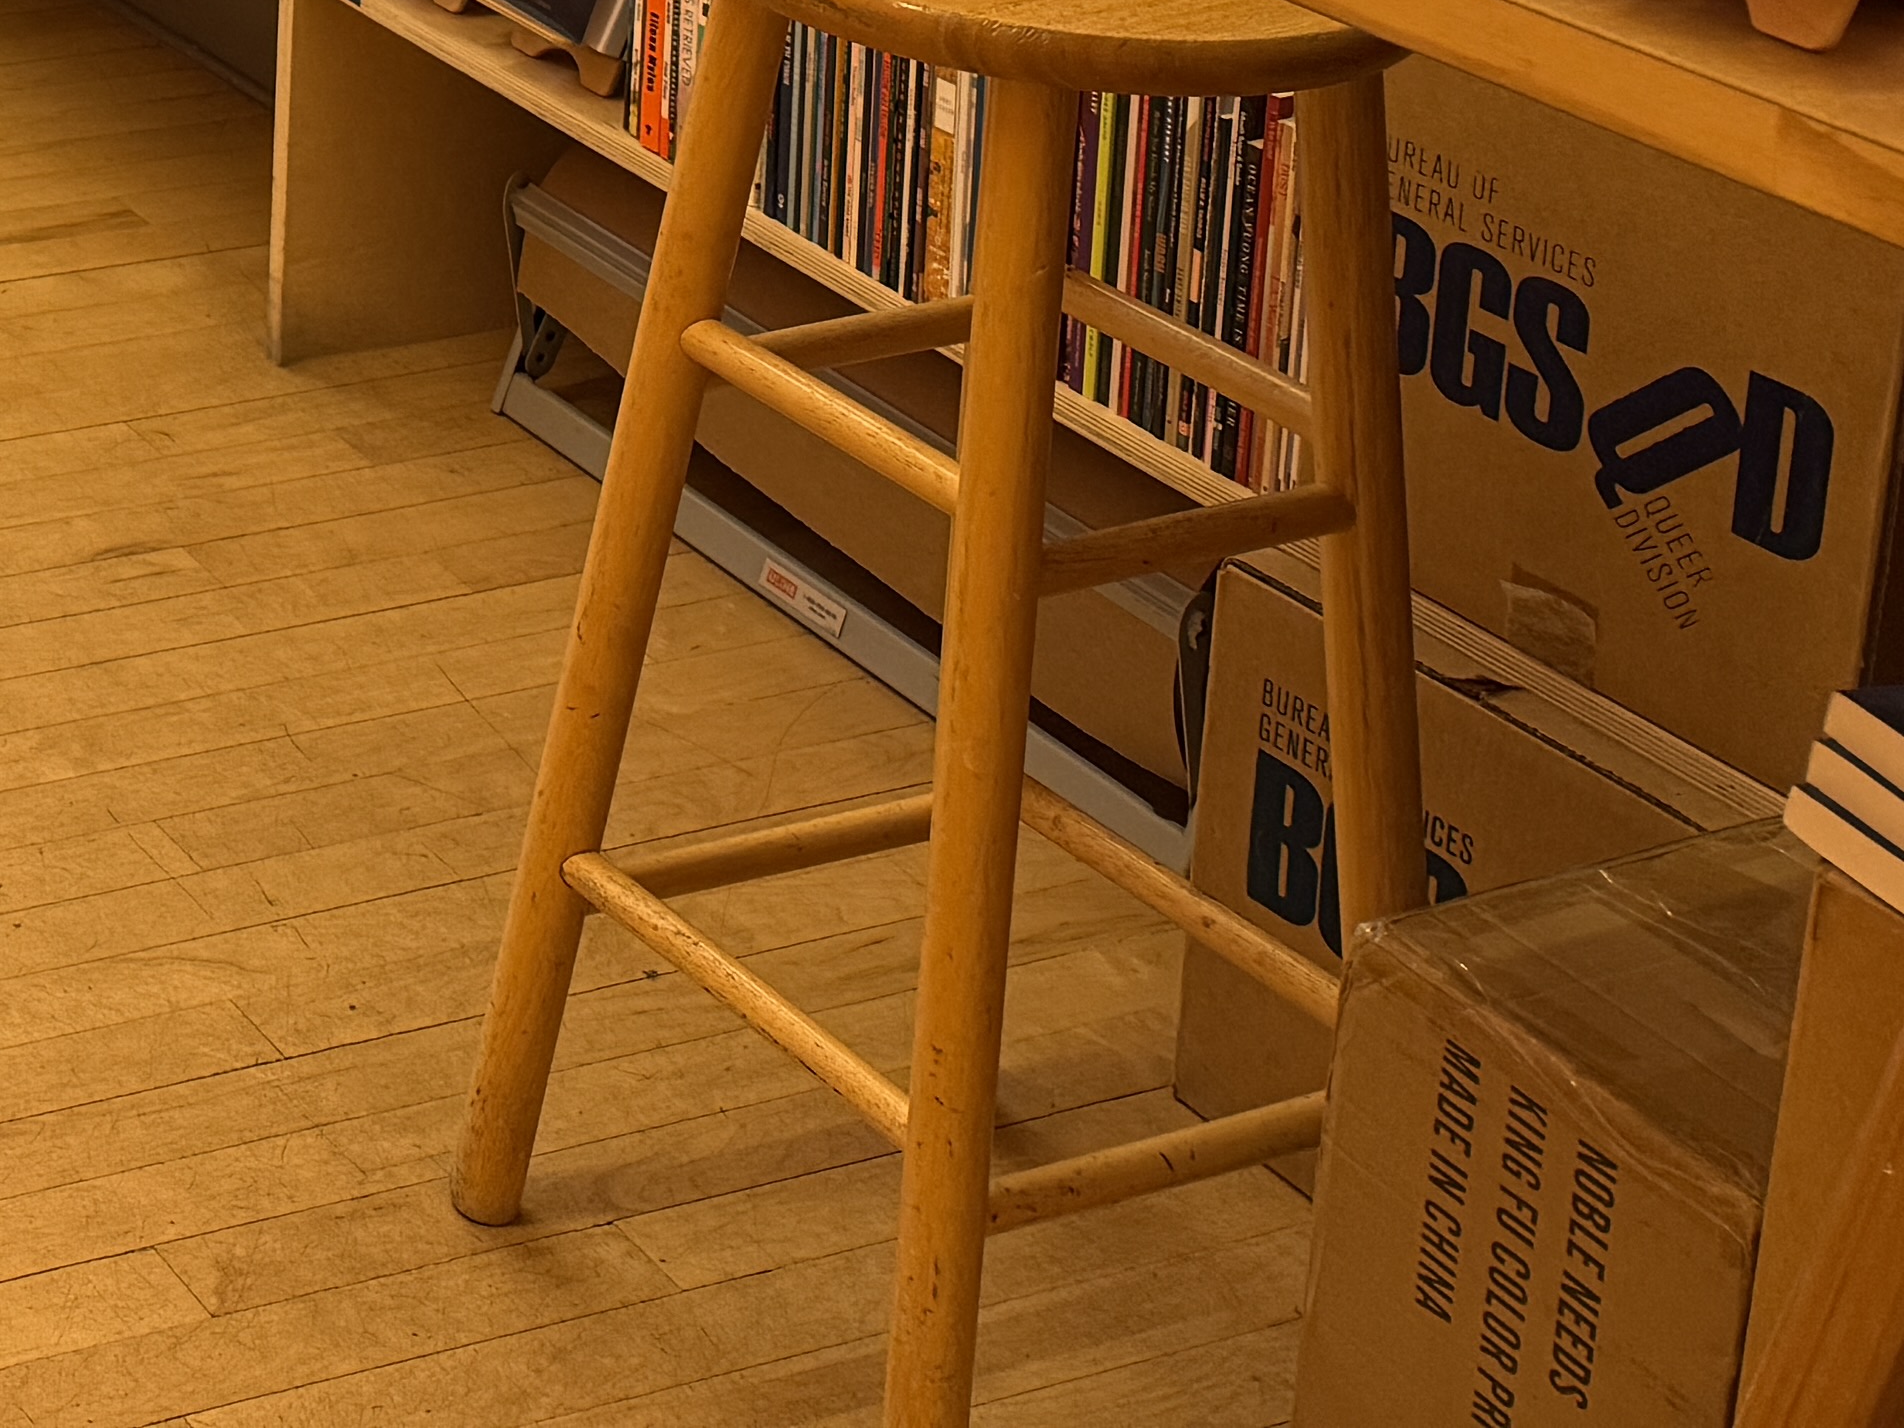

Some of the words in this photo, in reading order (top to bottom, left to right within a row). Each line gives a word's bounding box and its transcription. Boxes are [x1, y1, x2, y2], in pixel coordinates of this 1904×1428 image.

[1471, 171, 1500, 204] OF
[1480, 210, 1597, 288] SERVICES
[1612, 507, 1700, 631] DIVISION
[1643, 496, 1713, 587] QUEER
[1434, 1038, 1483, 1159] MADE
[1428, 1154, 1472, 1216] IN
[1566, 1138, 1620, 1280] NOBLE
[1414, 1197, 1467, 1324] CHINA
[1548, 1265, 1608, 1412] NEEDS
